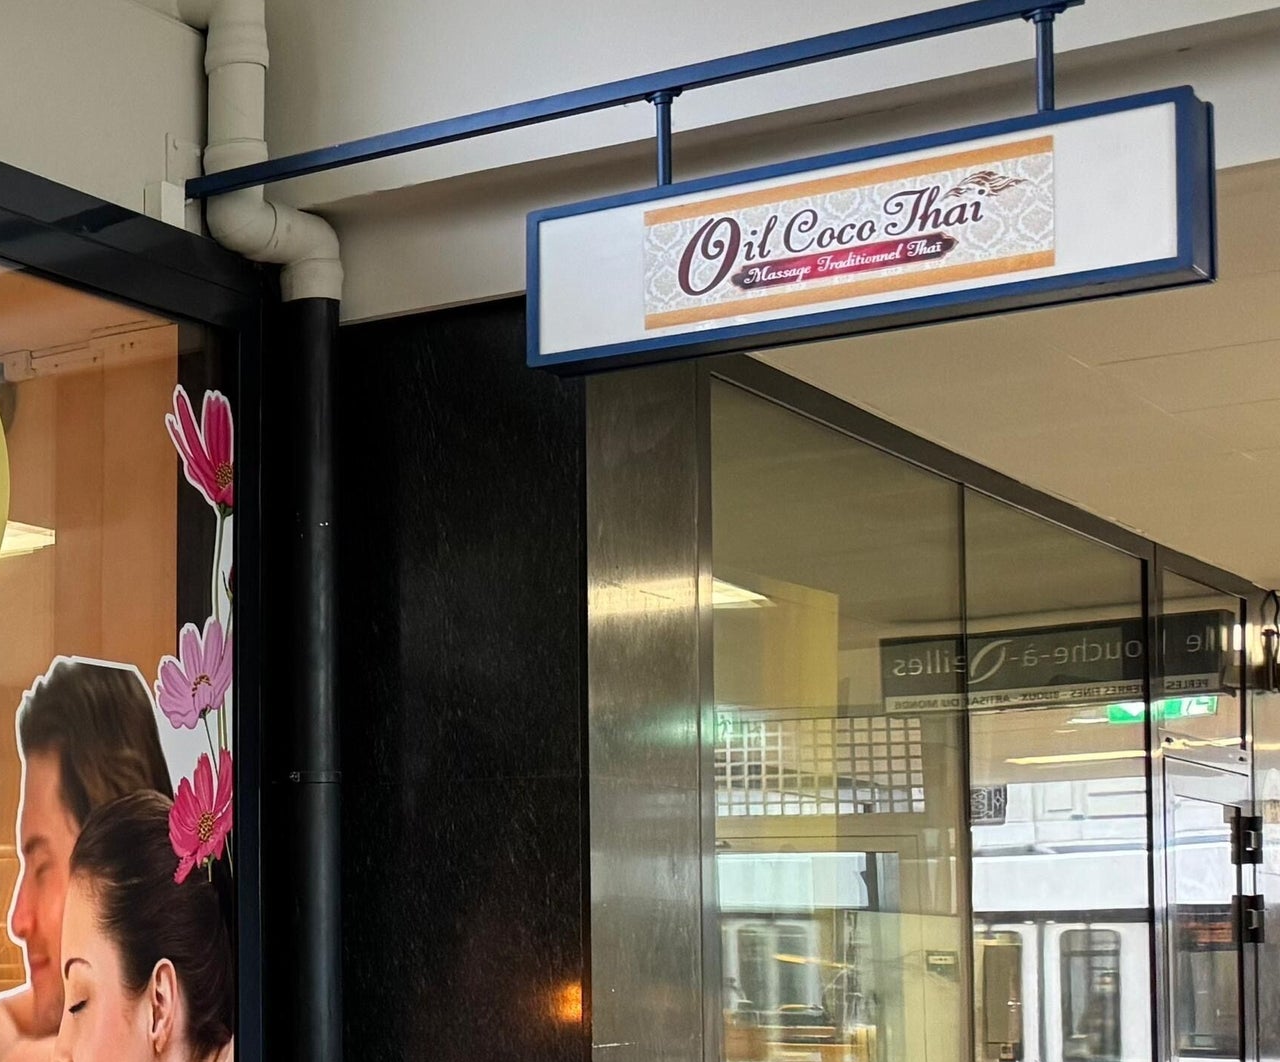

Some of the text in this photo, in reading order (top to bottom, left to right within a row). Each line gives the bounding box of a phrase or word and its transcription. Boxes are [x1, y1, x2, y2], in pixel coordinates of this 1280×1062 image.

[678, 185, 985, 296] Oil Coco Thai
[743, 264, 812, 285] Massage
[817, 243, 904, 272] Traditionnel
